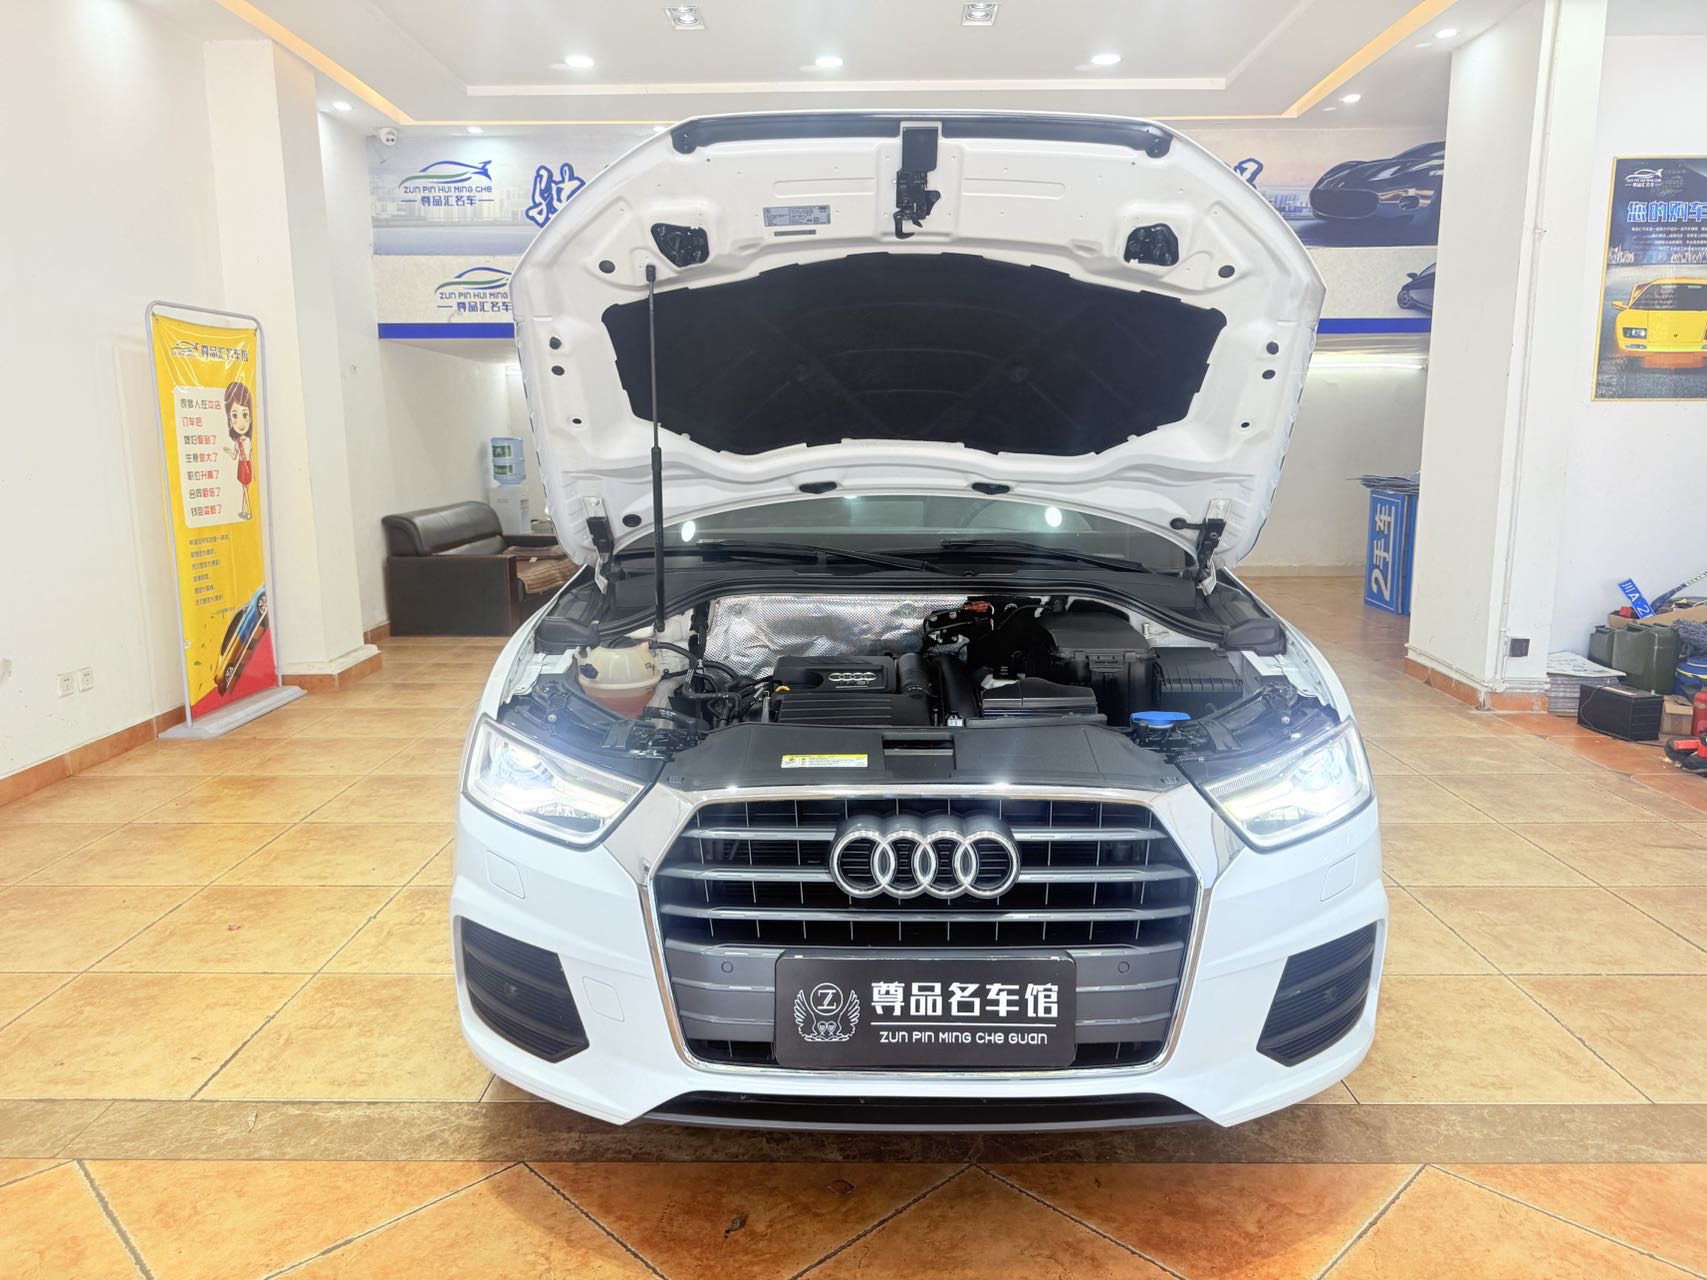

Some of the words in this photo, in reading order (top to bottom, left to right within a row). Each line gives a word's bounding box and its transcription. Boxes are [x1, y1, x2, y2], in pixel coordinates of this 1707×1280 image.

[420, 196, 477, 207] 尊品汇名车
[473, 292, 488, 300] HUI
[456, 301, 512, 313] 尊品汇名车
[871, 981, 1059, 1018] 尊品名车馆
